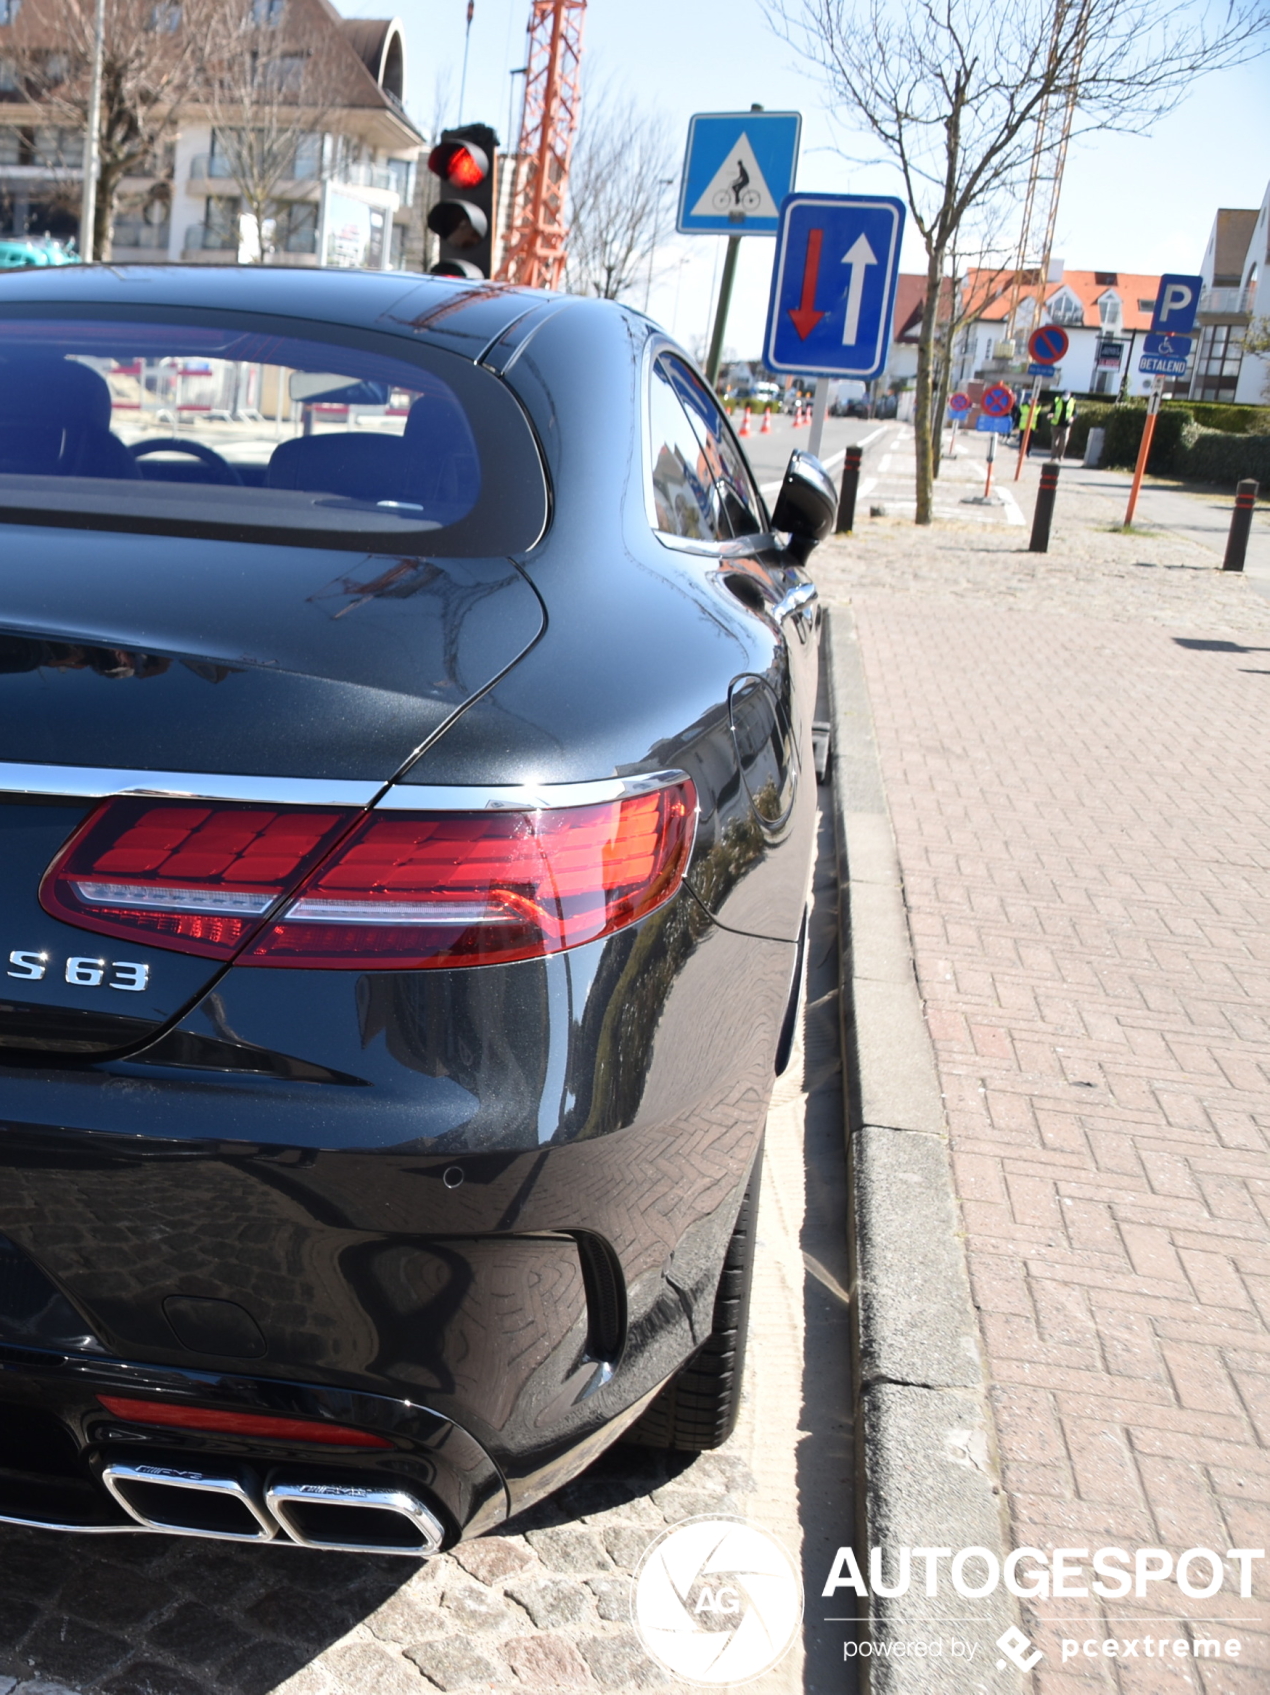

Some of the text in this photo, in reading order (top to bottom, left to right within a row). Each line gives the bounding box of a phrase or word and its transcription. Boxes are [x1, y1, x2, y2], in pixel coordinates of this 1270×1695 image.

[1159, 283, 1192, 322] P
[1139, 357, 1186, 373] BETALEND
[7, 950, 150, 991] S 63
